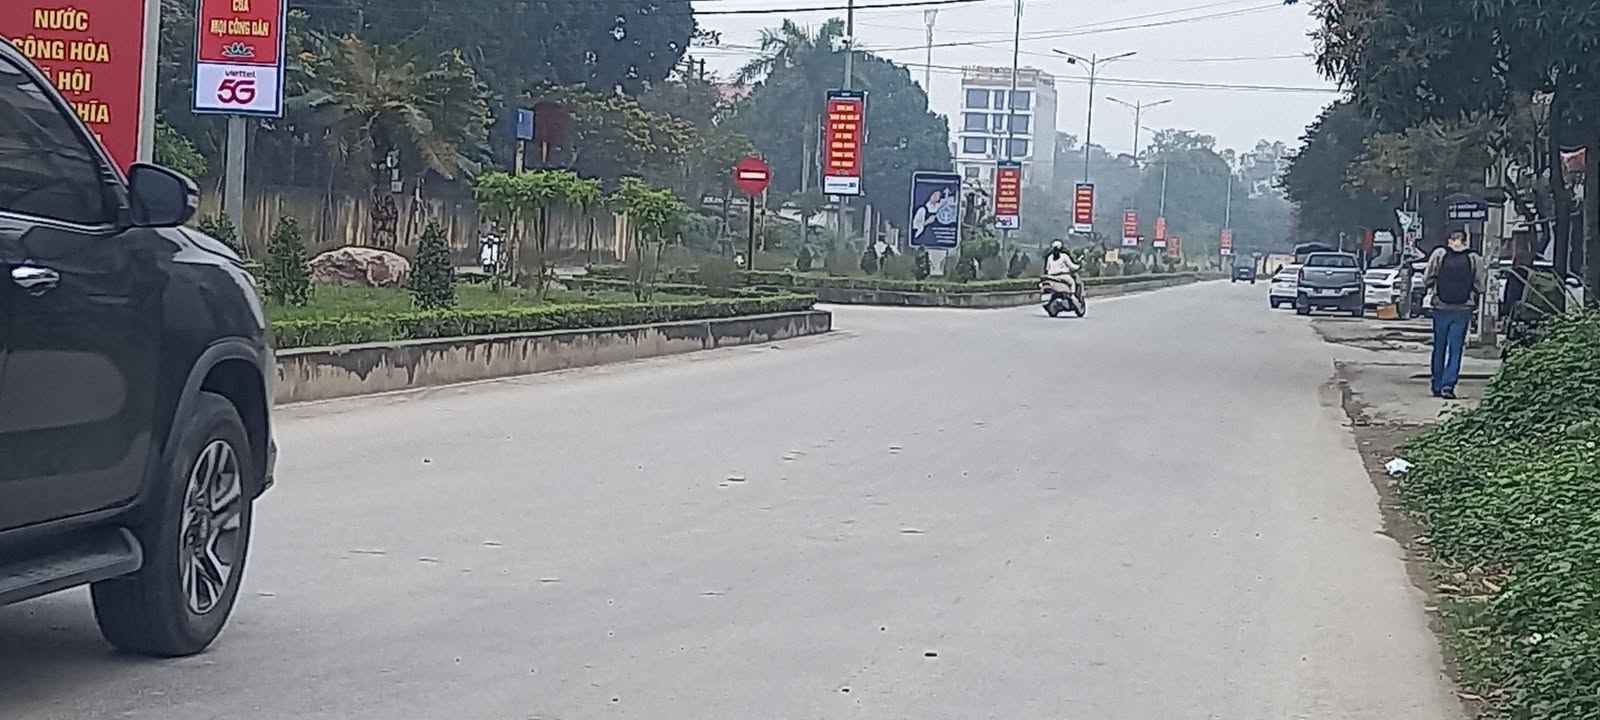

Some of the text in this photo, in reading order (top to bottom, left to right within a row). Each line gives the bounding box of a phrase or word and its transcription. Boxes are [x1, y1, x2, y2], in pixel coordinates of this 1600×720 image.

[34, 7, 89, 31] NƯỚC
[70, 38, 110, 62] HÒA
[58, 68, 91, 95] HỘI
[225, 69, 256, 78] viettel
[217, 79, 256, 104] 5G
